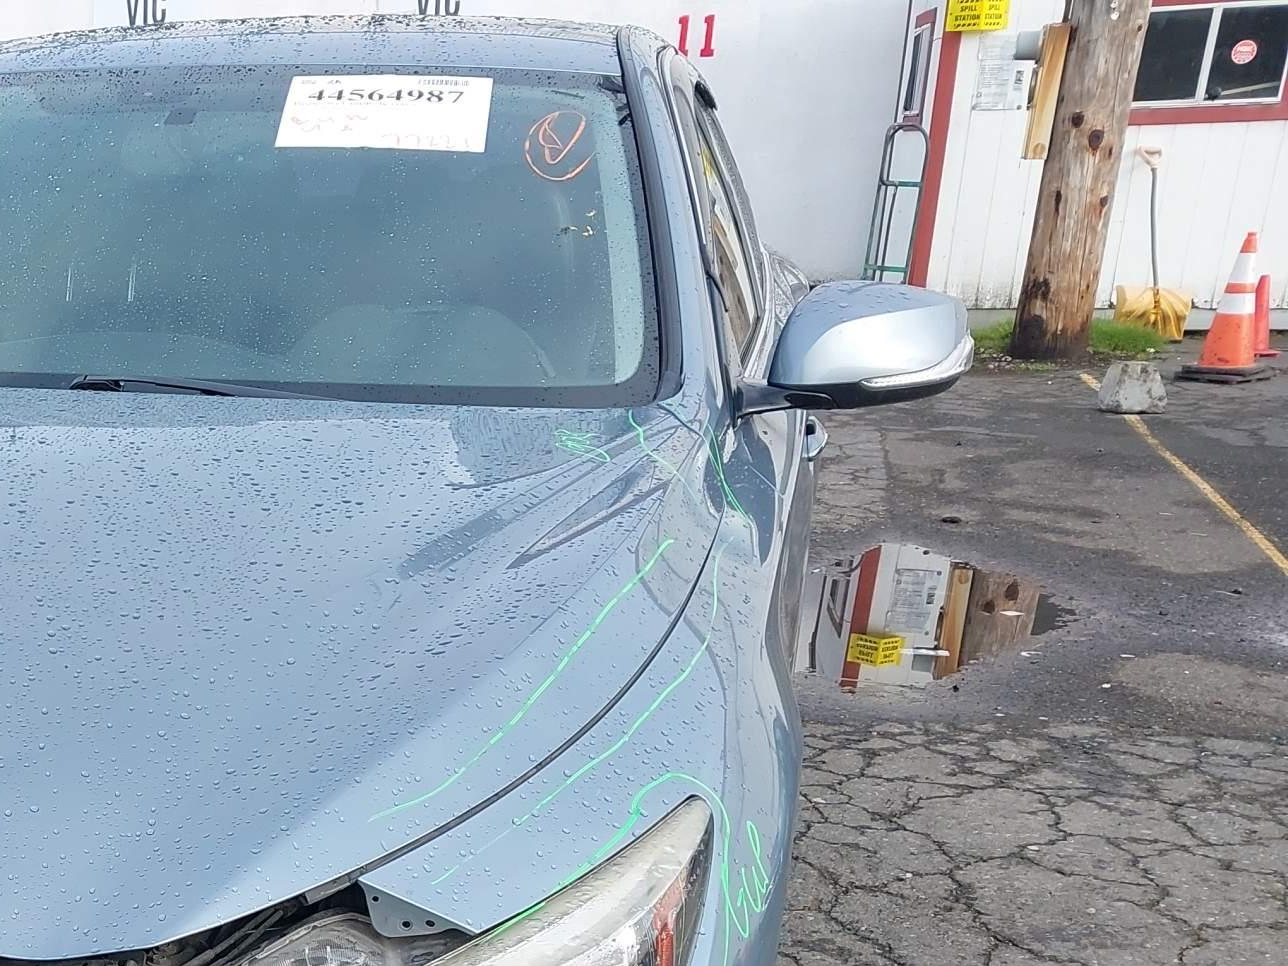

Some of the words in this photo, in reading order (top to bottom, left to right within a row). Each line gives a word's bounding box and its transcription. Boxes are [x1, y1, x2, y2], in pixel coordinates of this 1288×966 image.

[954, 14, 981, 22] STATION
[678, 14, 715, 57] 11
[308, 88, 465, 104] 44564987
